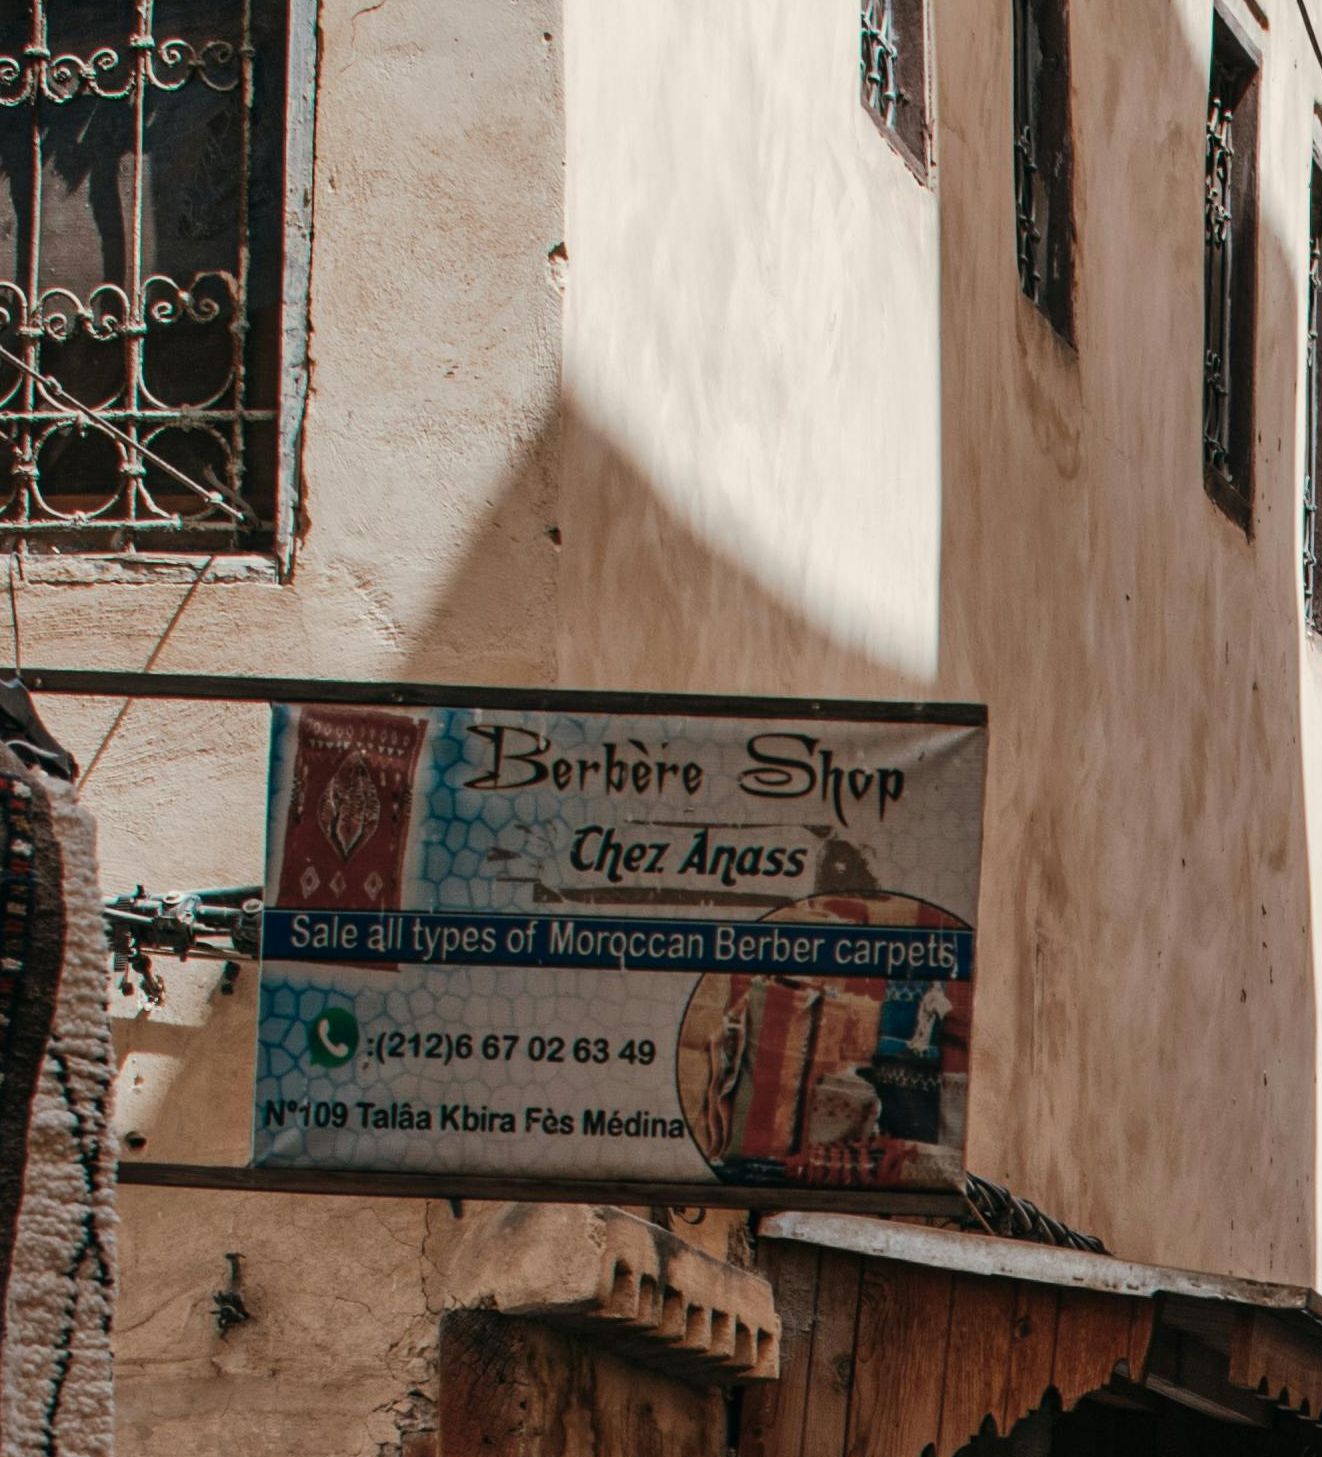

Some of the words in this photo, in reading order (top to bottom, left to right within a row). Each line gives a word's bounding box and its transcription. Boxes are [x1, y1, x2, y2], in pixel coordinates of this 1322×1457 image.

[463, 724, 702, 795] Berbère
[739, 733, 905, 827] Shop
[570, 826, 670, 883] Chez
[679, 827, 808, 887] Anass
[290, 914, 358, 949] Sale
[367, 914, 403, 951] all
[412, 917, 498, 961] types
[506, 920, 539, 953] of
[550, 920, 704, 958] Moroccan
[714, 926, 825, 963] Berber
[834, 933, 956, 975] carpets
[482, 1034, 519, 1061] 67
[527, 1036, 566, 1063] 02
[573, 1037, 610, 1064] 63
[618, 1038, 656, 1065] 49
[356, 1099, 432, 1131] Talâa
[440, 1104, 516, 1132] Kbira
[525, 1107, 575, 1135] Fès
[583, 1110, 685, 1139] Médina
